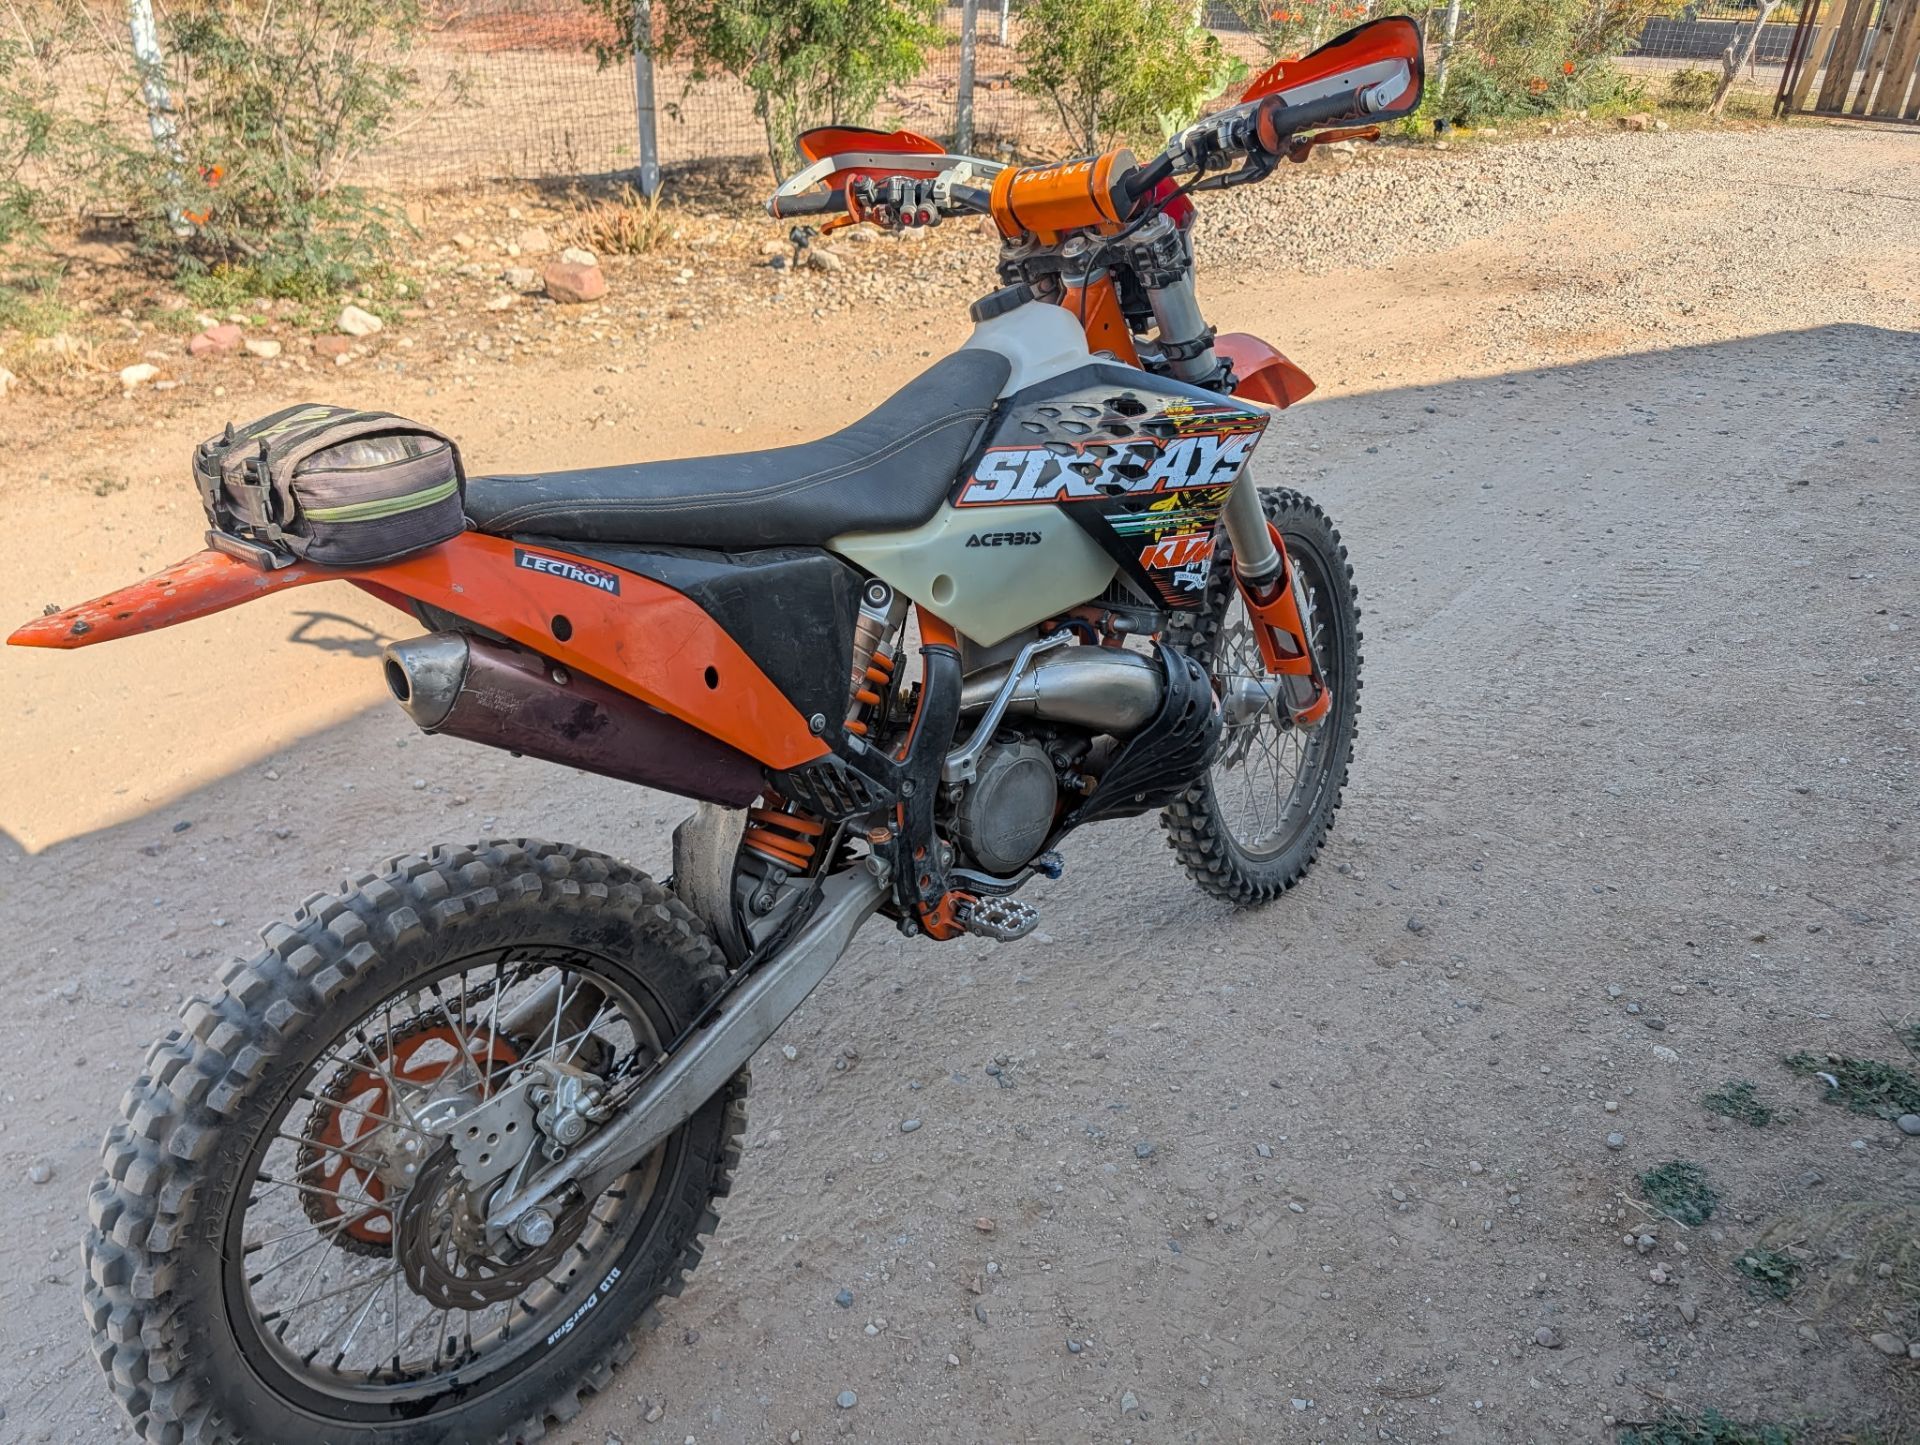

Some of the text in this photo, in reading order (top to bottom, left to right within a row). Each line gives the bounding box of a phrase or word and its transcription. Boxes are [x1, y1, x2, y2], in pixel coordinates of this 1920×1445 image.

[1014, 162, 1093, 184] RACING
[1139, 534, 1218, 571] KTM
[521, 554, 614, 592] LECTRON
